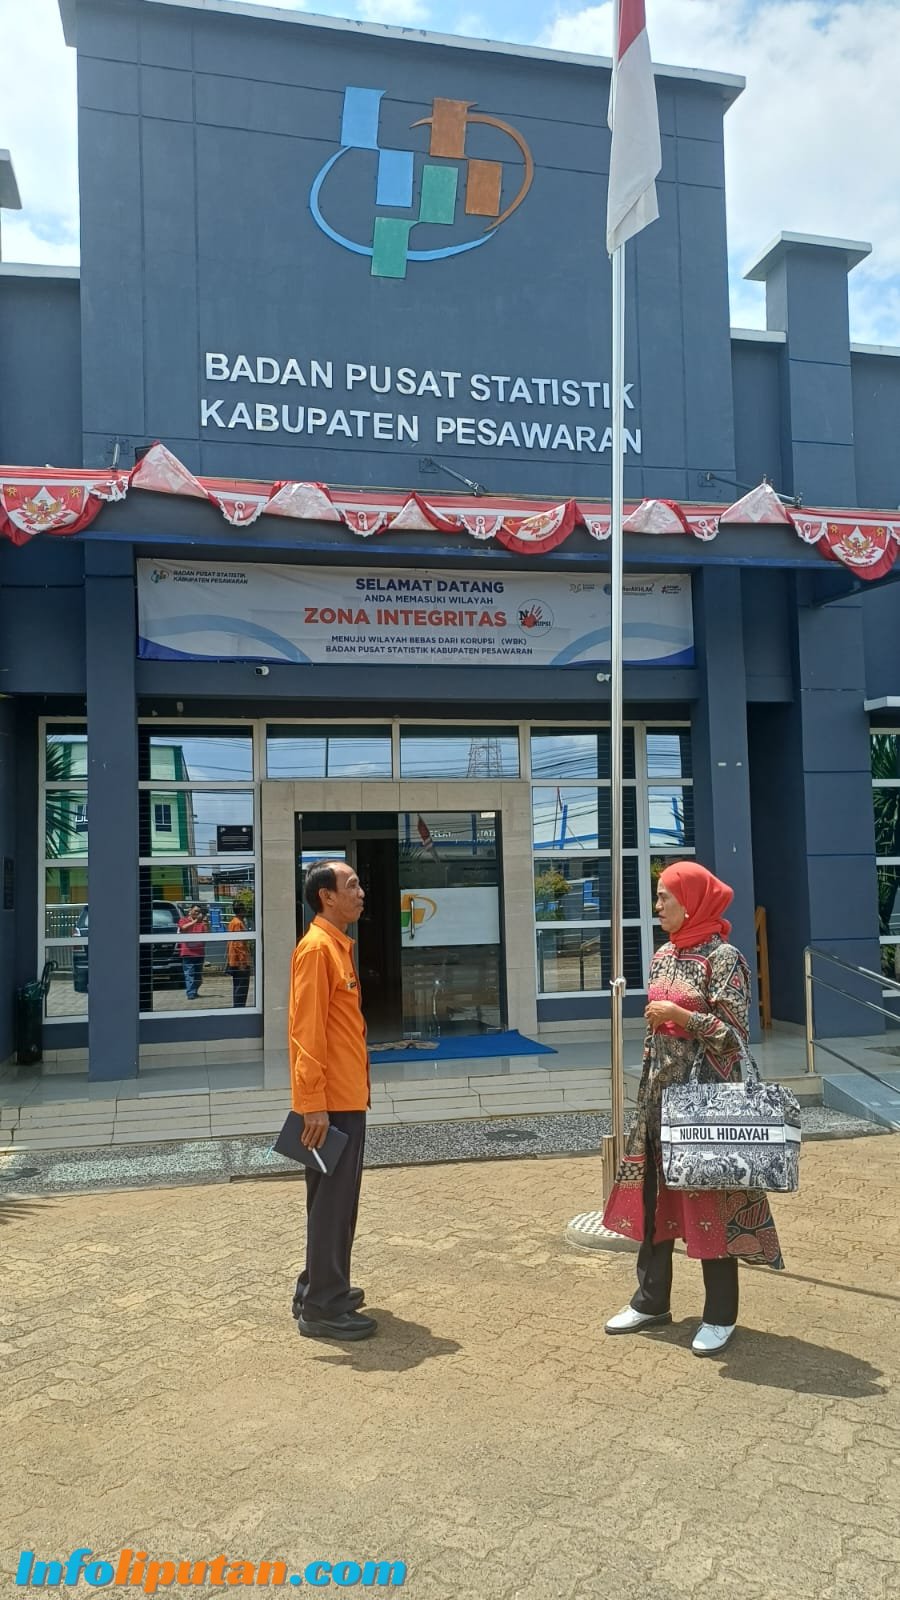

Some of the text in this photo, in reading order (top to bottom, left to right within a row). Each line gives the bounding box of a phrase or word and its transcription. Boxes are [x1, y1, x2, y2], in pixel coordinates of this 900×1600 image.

[205, 352, 333, 389] BADAN
[346, 363, 461, 400] PUSAT
[201, 399, 642, 455] KABUPATEN PESAWARAN
[356, 578, 504, 593] SELAMAT DATANG
[364, 594, 493, 604] ANDA MEMASUKI WILAYAH
[304, 607, 507, 627] ZONA INTEGRITAS
[331, 635, 366, 643] MENUJU
[460, 637, 495, 645] KORUPSI
[501, 638, 527, 646] (WBK)
[325, 645, 356, 653] BADAN
[387, 646, 427, 654] STATISTIK
[430, 646, 480, 654] KABUPATEN
[481, 647, 533, 655] PESAWARAN
[679, 1127, 769, 1141] NURUL HIDAYAH
